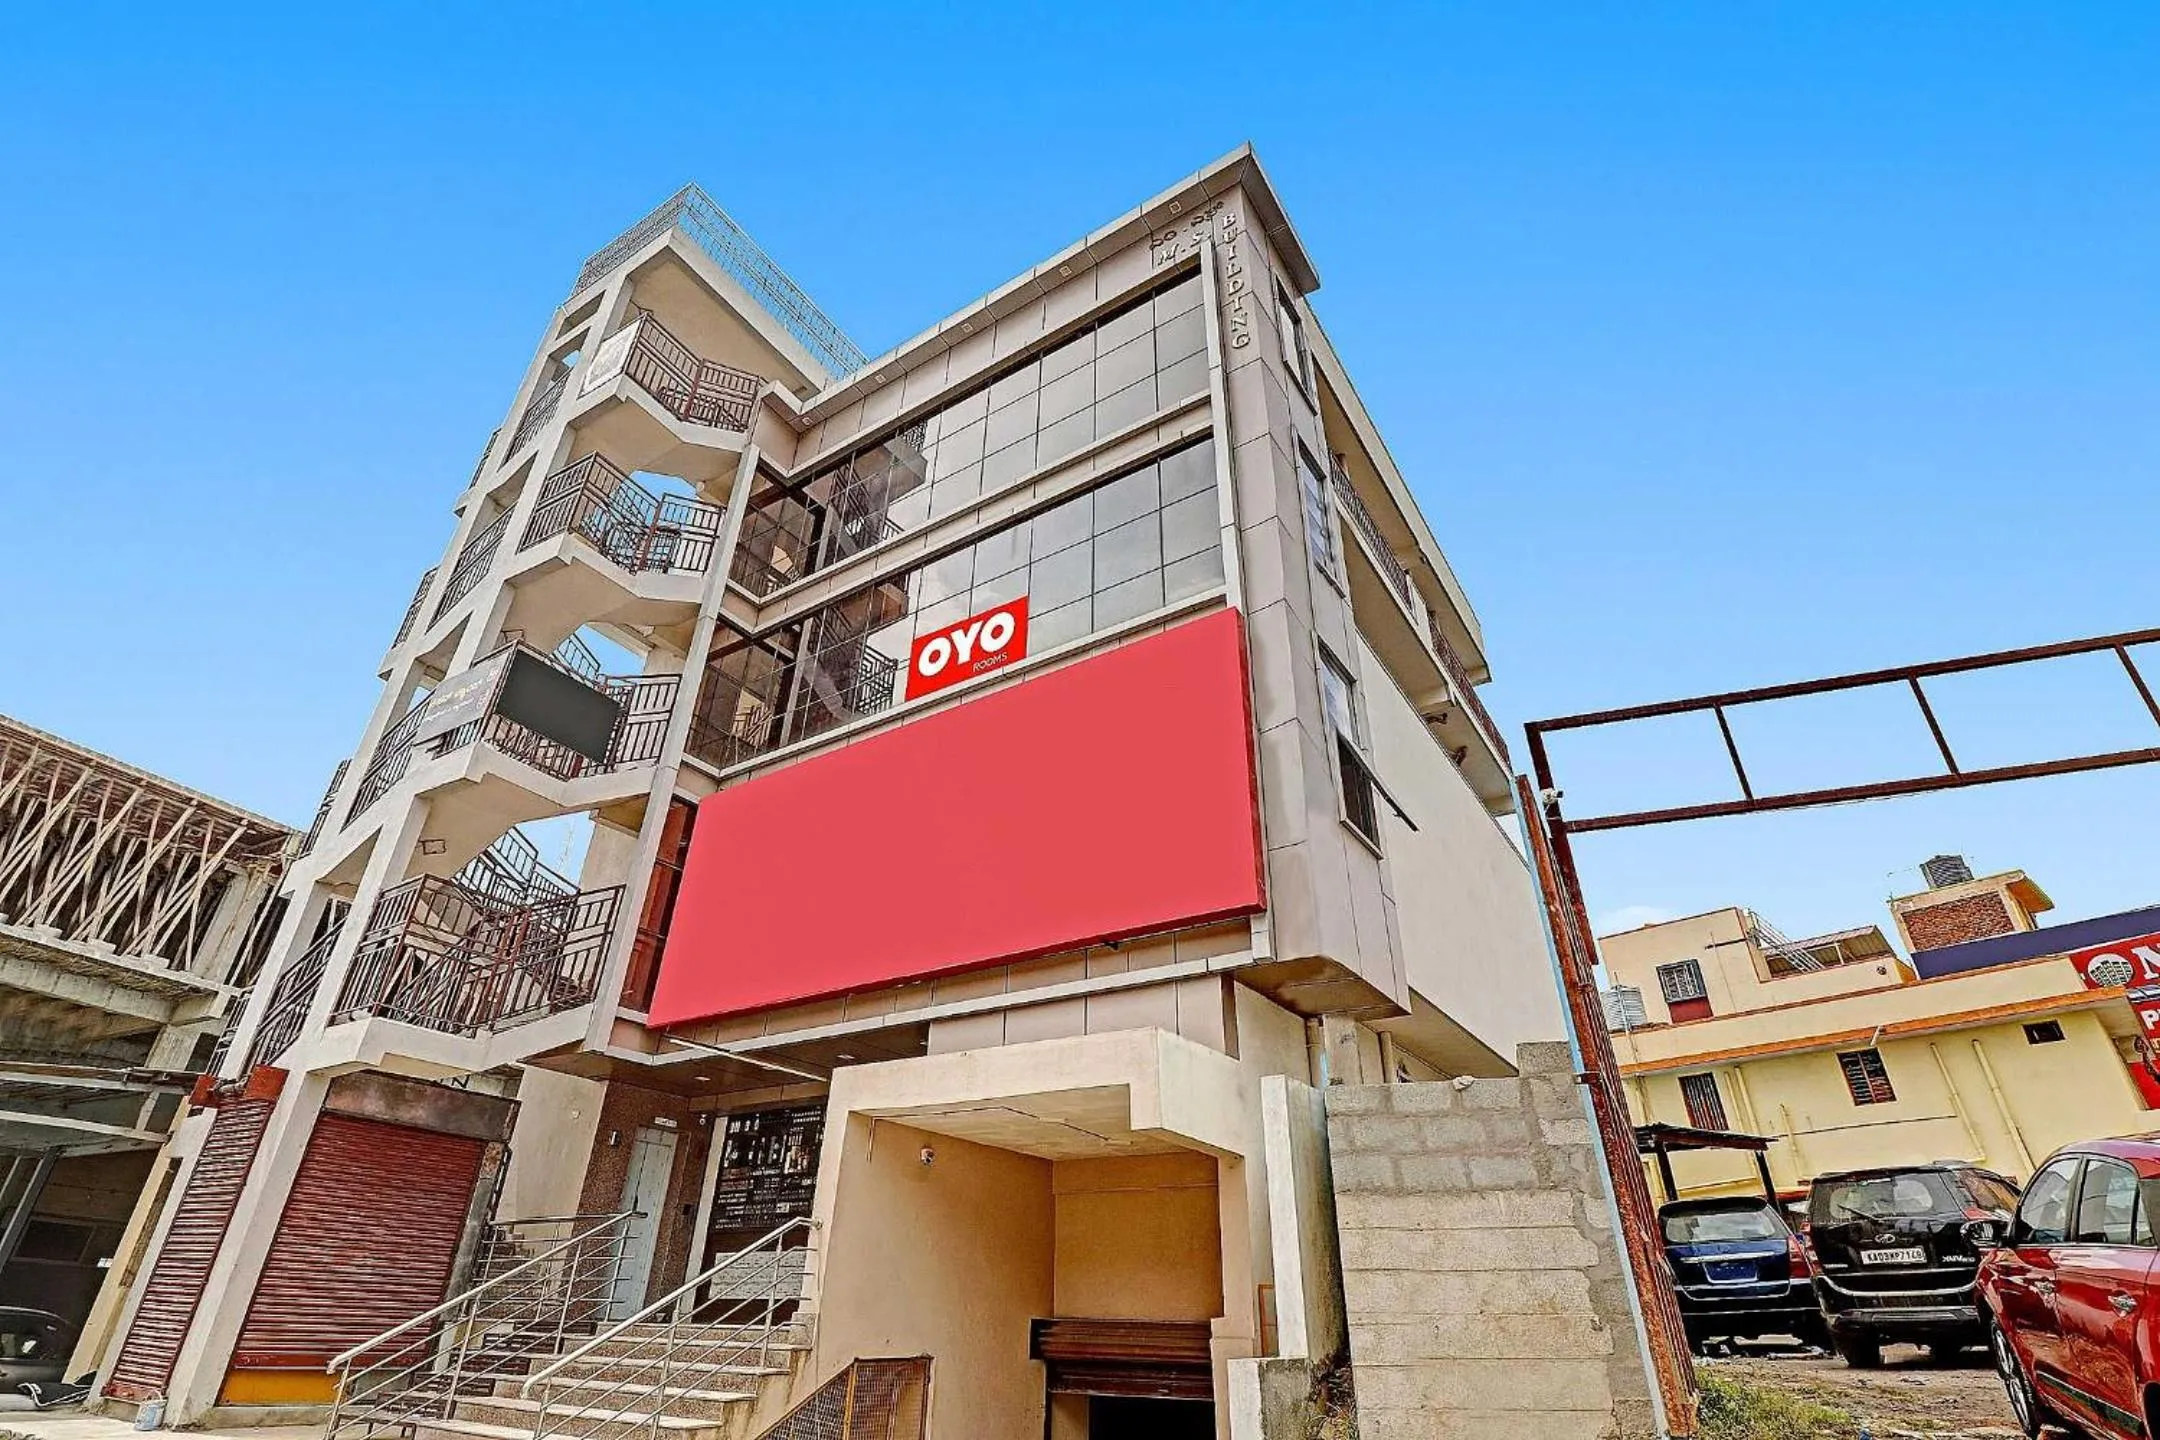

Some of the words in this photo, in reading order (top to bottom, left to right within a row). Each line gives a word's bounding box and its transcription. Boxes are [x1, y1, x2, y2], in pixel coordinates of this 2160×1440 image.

[1221, 211, 1251, 350] BUILDING
[918, 611, 1016, 677] OYO
[973, 652, 1008, 672] ROOMS
